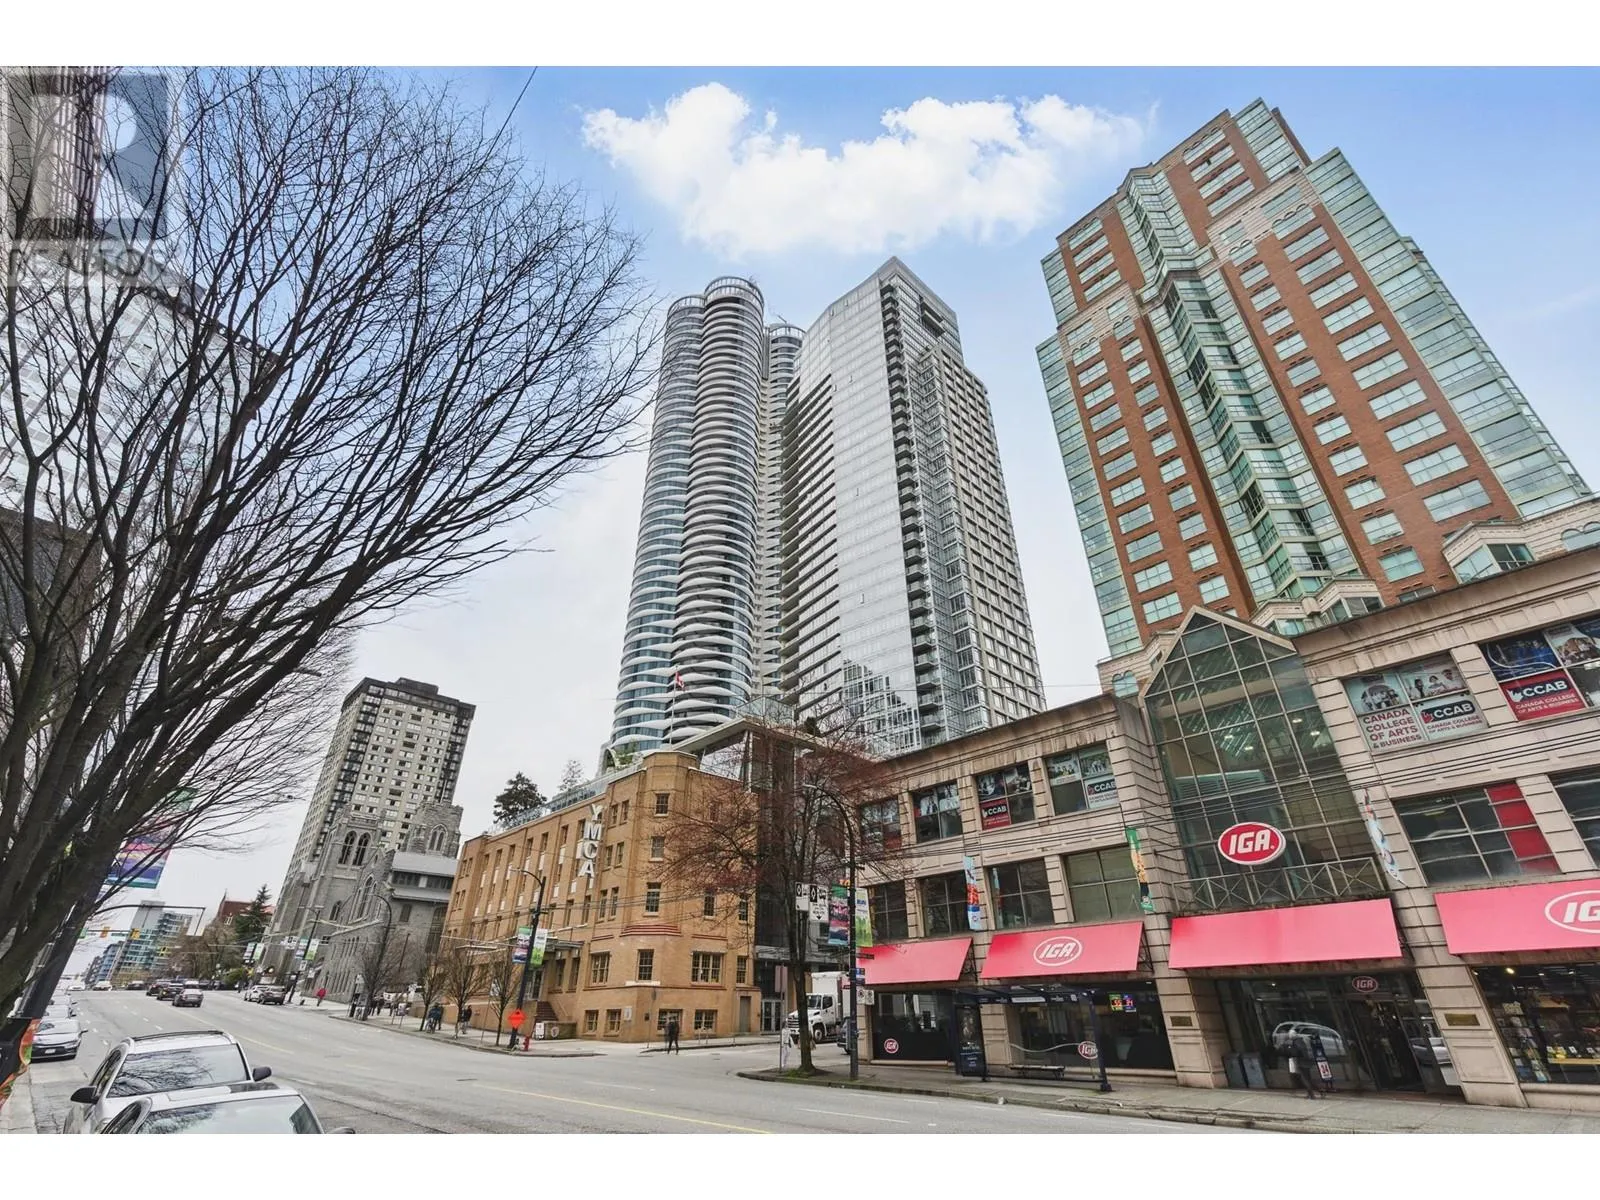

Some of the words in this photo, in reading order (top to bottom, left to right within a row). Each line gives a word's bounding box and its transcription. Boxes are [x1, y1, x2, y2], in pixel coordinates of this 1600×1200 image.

[1523, 680, 1567, 697] CCAB
[1363, 707, 1411, 725] CANADA
[1433, 702, 1473, 718] CCAB
[1366, 716, 1414, 733] COLLEGE
[1369, 731, 1385, 741] OF
[1388, 725, 1418, 739] ARTS
[1373, 741, 1379, 749] &
[1380, 733, 1422, 748] BUSINESS
[988, 805, 1007, 815] CCAB
[577, 803, 603, 878] YMCA
[1229, 829, 1272, 856] IGA
[1563, 901, 1600, 923] IG
[1038, 942, 1075, 959] IGA
[1356, 979, 1374, 989] IGA
